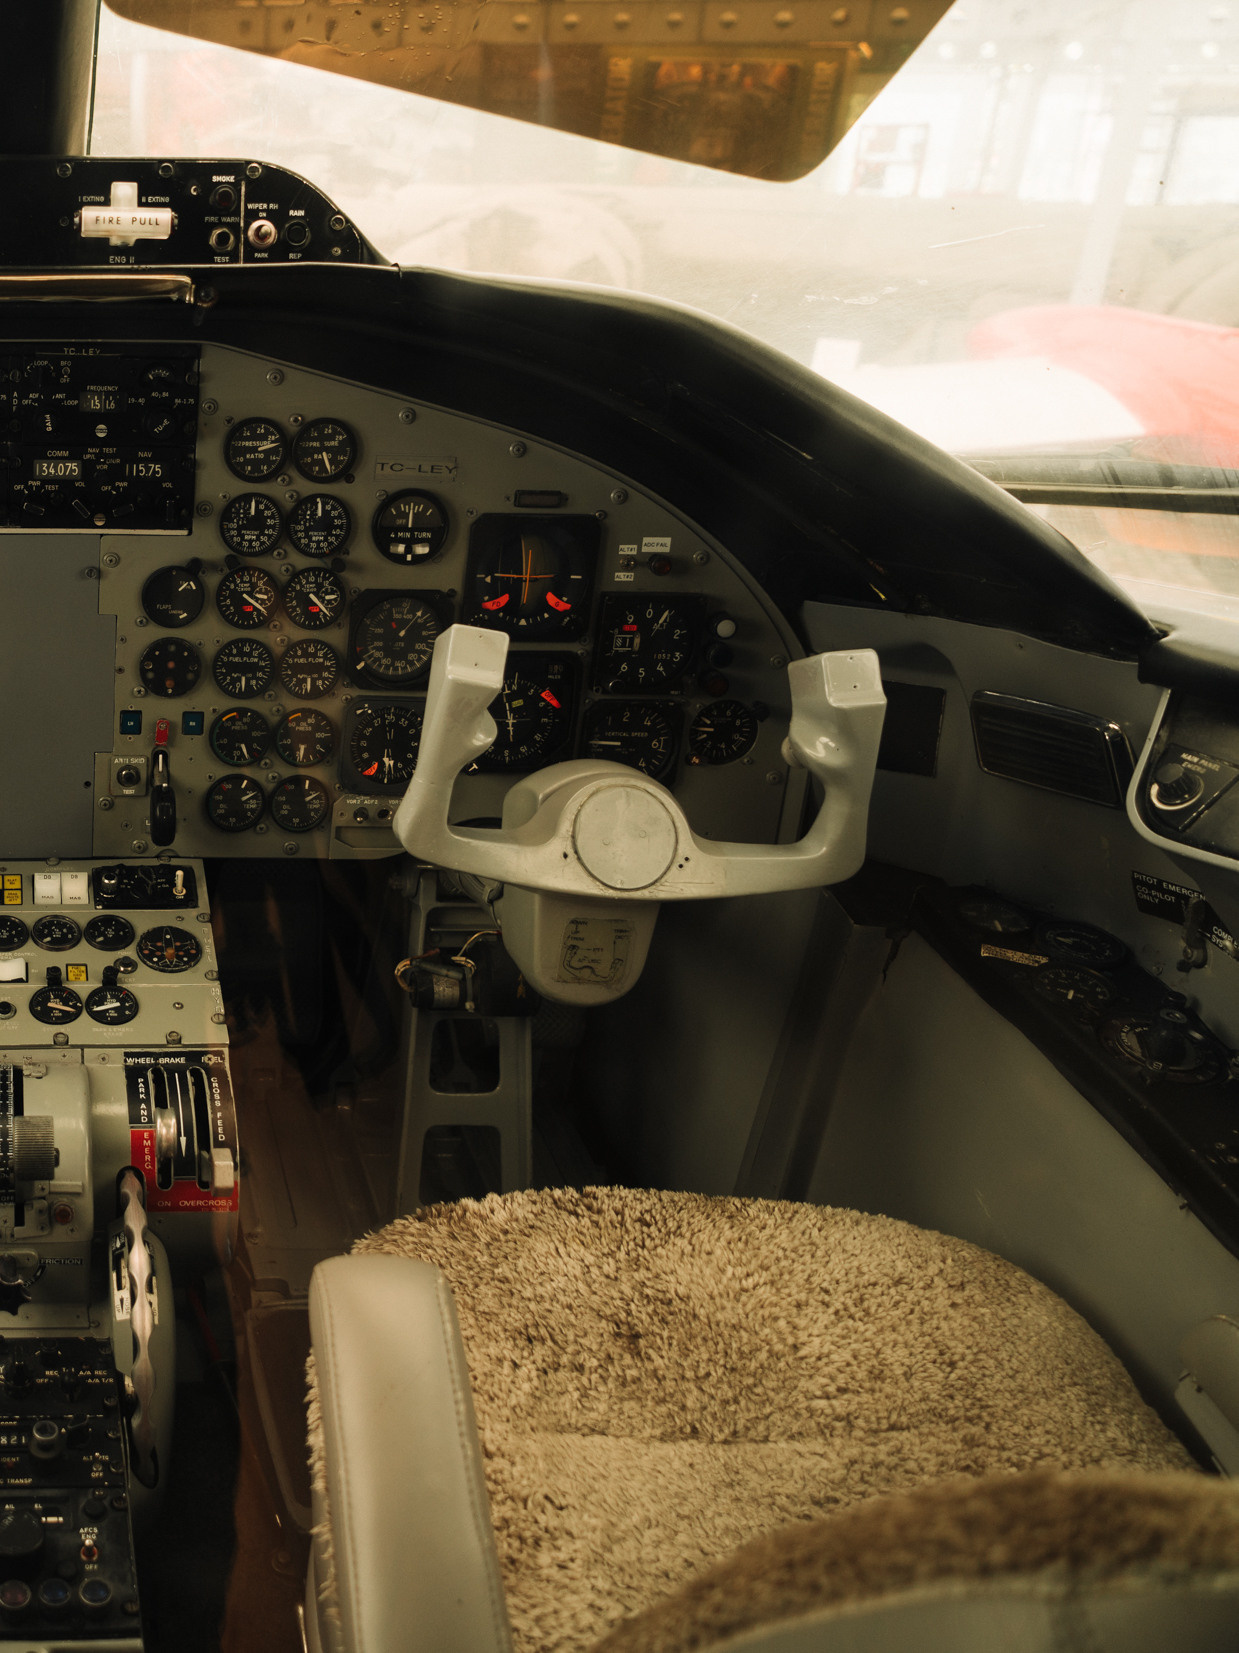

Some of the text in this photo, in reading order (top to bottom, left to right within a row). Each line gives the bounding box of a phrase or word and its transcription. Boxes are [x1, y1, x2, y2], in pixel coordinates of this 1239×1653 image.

[83, 195, 105, 203] EXTING
[289, 209, 305, 217] RAIN
[95, 215, 160, 226] FIRE PULL
[221, 216, 240, 224] WARN
[109, 256, 126, 264] ENG
[288, 252, 302, 260] REP
[47, 450, 69, 458] COMM
[36, 462, 79, 476] 134.075
[1133, 872, 1158, 885] PITOT
[1136, 885, 1176, 903] CO-PILOT
[1137, 892, 1159, 904] ONLY
[137, 1077, 148, 1123] PARK AND
[210, 1076, 226, 1142] CROSS FEED
[84, 1563, 98, 1571] OFF
